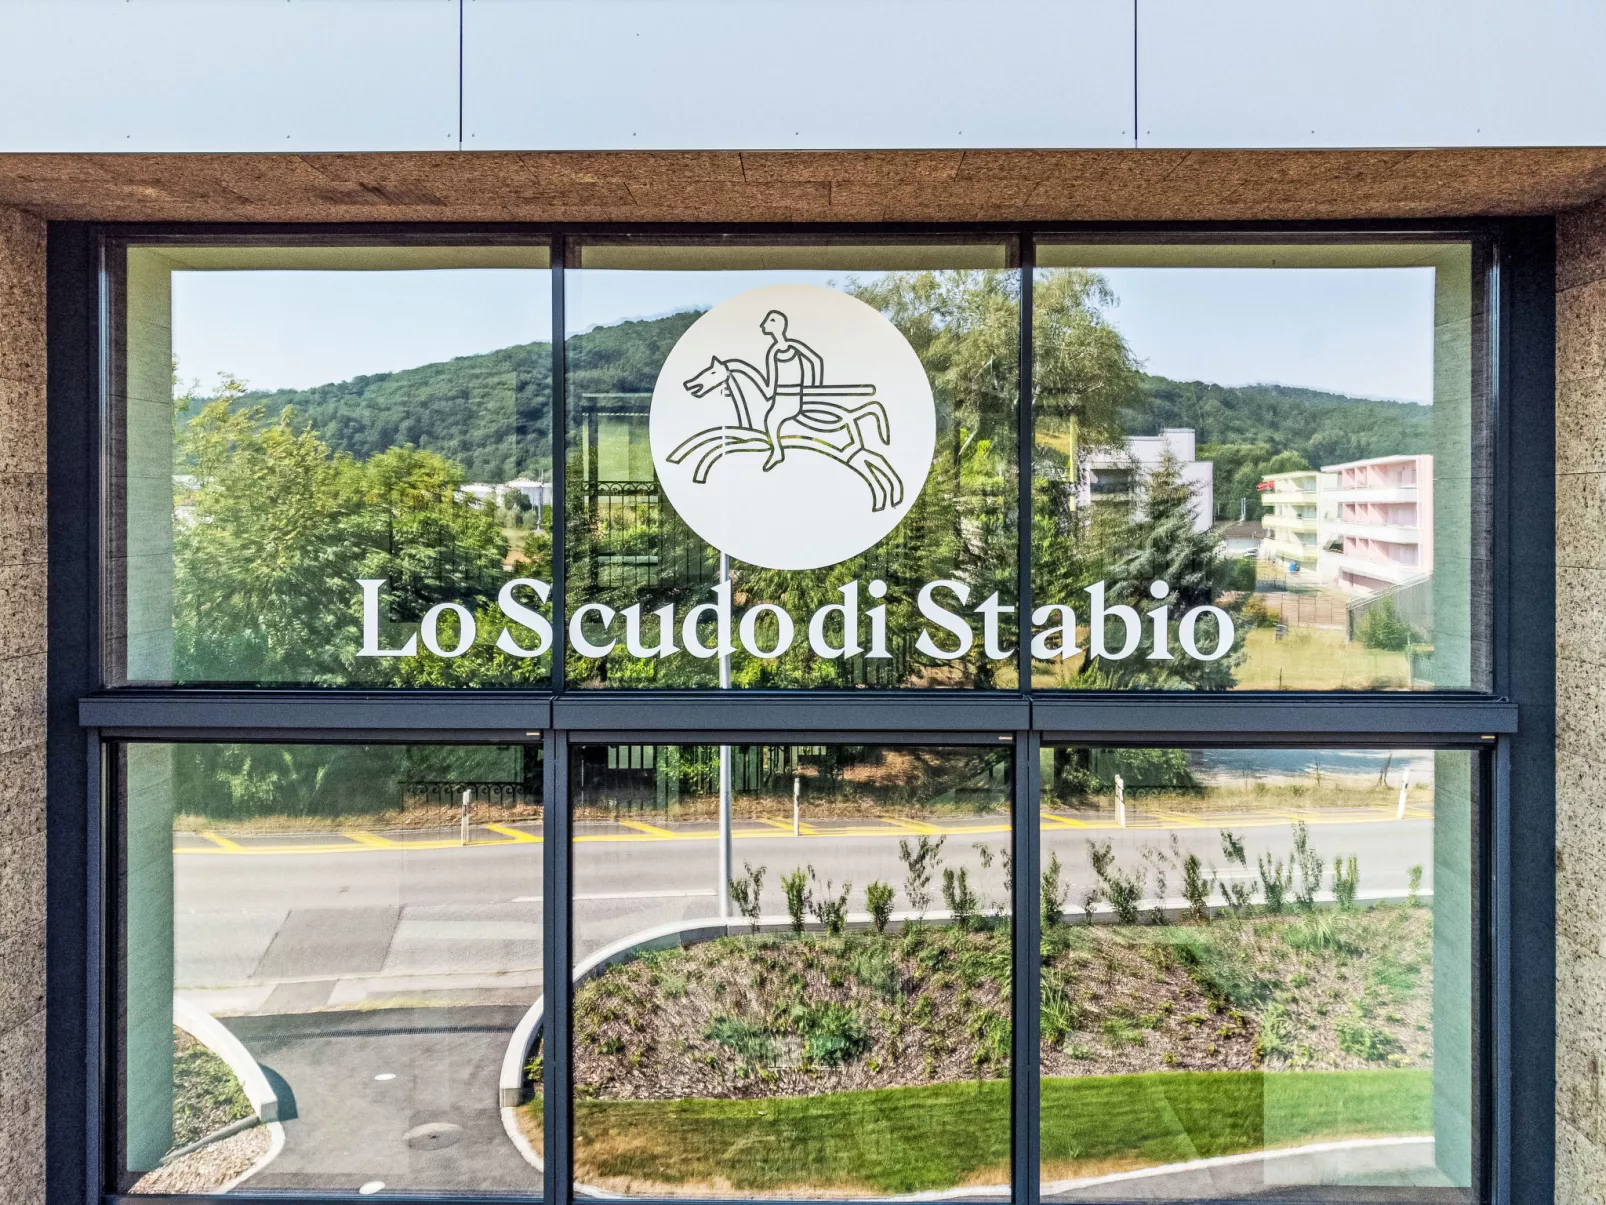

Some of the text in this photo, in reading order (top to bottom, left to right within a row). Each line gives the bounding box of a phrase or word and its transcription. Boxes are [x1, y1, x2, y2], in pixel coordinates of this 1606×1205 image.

[355, 578, 1236, 662] Lo Scudo di Stabio
